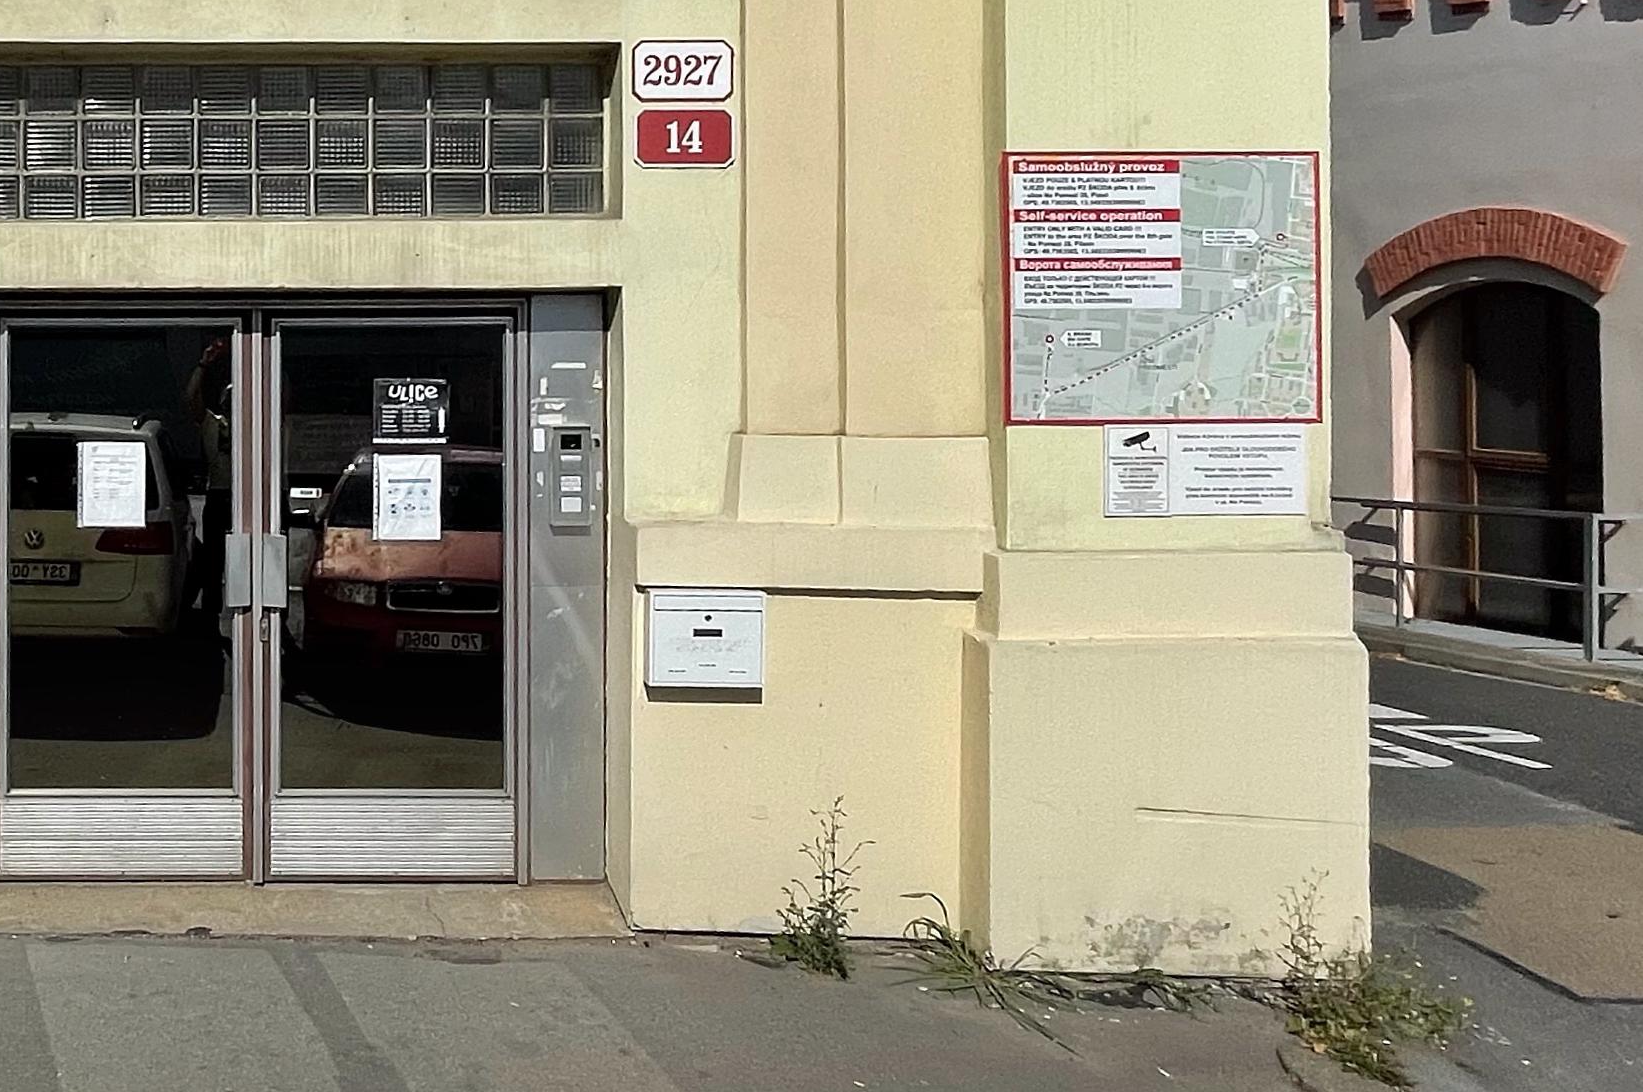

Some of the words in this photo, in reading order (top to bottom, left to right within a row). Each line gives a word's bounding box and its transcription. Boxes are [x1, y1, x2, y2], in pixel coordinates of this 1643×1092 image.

[642, 54, 724, 86] 2927
[665, 120, 704, 154] 14
[1119, 162, 1165, 173] provoz
[1019, 210, 1097, 222] Self-service
[1099, 210, 1163, 222] operation
